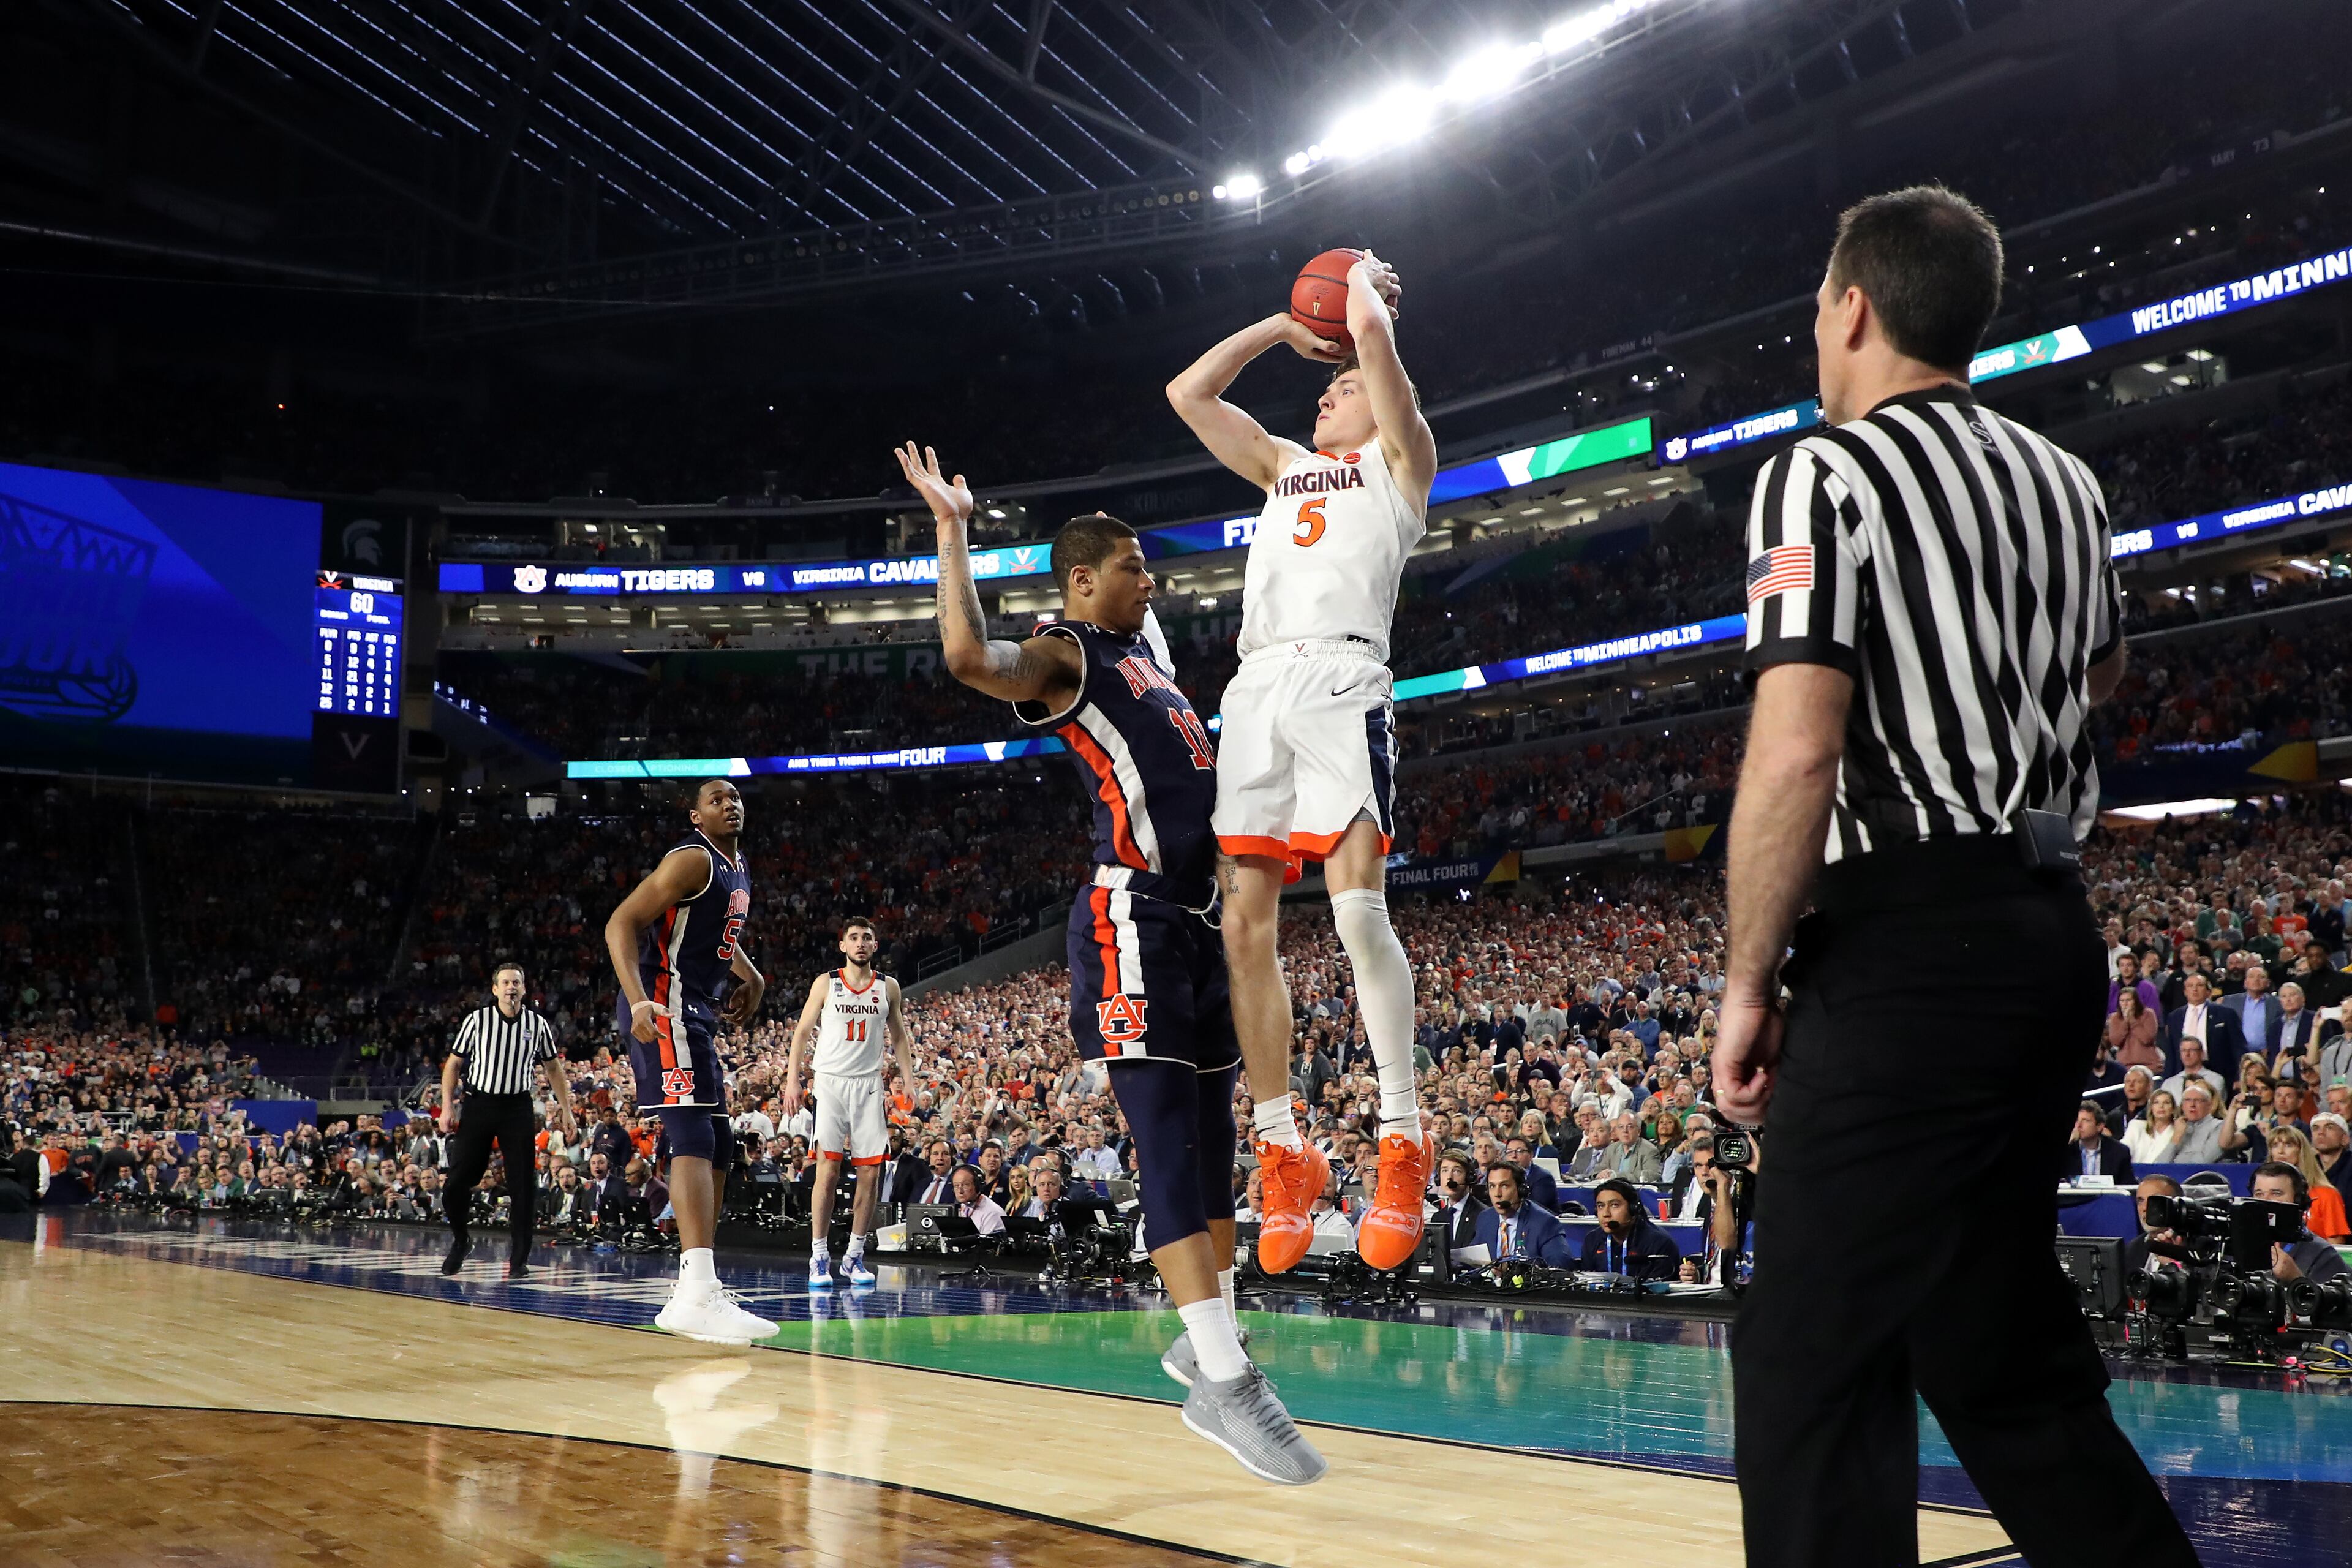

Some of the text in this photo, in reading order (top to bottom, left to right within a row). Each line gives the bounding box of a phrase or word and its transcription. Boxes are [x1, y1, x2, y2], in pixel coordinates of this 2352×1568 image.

[2132, 285, 2227, 334] WELCOME
[2229, 280, 2250, 302] TO
[1692, 409, 1798, 450] AUBURN TIGERS
[1275, 467, 1365, 499] VIRGINIA
[1224, 515, 1258, 547] FI
[1292, 497, 1327, 547] 5
[2176, 522, 2199, 540] VS
[2222, 500, 2296, 529] VIRGINIA
[555, 552, 1000, 591] AUBURN TIGERS VS VIRGINIA CAVALRS
[352, 577, 394, 593] VIRGINIA
[350, 592, 374, 614] 60
[385, 646, 393, 658] 2
[1526, 625, 1702, 673] WELCOME TO MINNEAPOLIS
[348, 656, 360, 668] 12
[367, 658, 374, 670] 4
[385, 660, 392, 671] 1
[322, 668, 333, 680] 11
[384, 674, 392, 685] 4
[320, 682, 333, 695] 12
[366, 687, 374, 698] 2
[385, 688, 390, 700] 1
[347, 699, 355, 711] 2
[383, 702, 390, 714] 1
[788, 758, 809, 769] AND
[810, 756, 836, 768] THEN
[872, 753, 899, 765] WERE
[900, 747, 946, 766] FOUR
[1392, 869, 1431, 886] FINAL
[1433, 864, 1470, 881] FOUR
[717, 918, 744, 960] 5
[835, 1005, 880, 1014] VIRGINIA
[845, 1017, 866, 1042] 11
